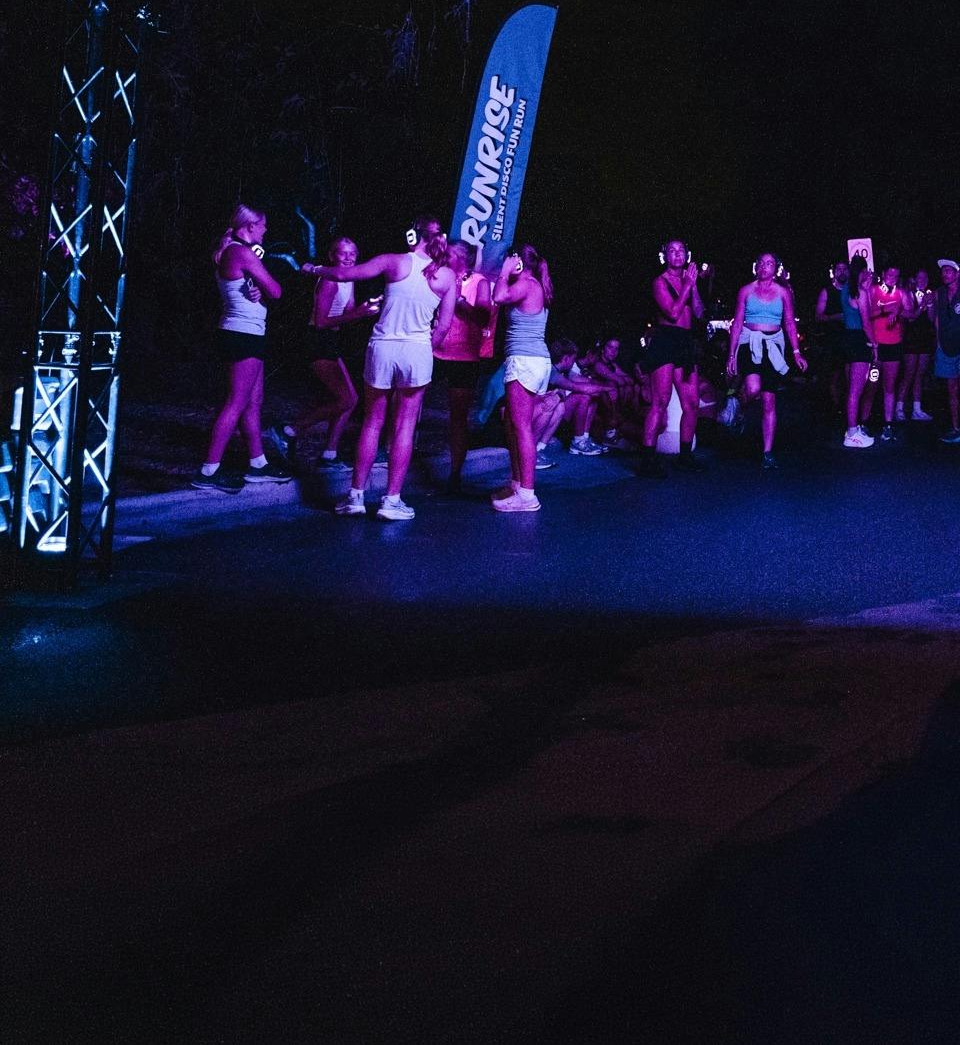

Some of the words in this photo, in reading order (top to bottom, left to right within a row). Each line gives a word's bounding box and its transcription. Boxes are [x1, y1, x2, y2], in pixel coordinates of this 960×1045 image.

[461, 76, 515, 249] RUNRISE
[492, 197, 506, 242] SILENT
[500, 157, 512, 197] DISCO
[506, 128, 520, 156] FUN
[513, 99, 526, 128] RUN
